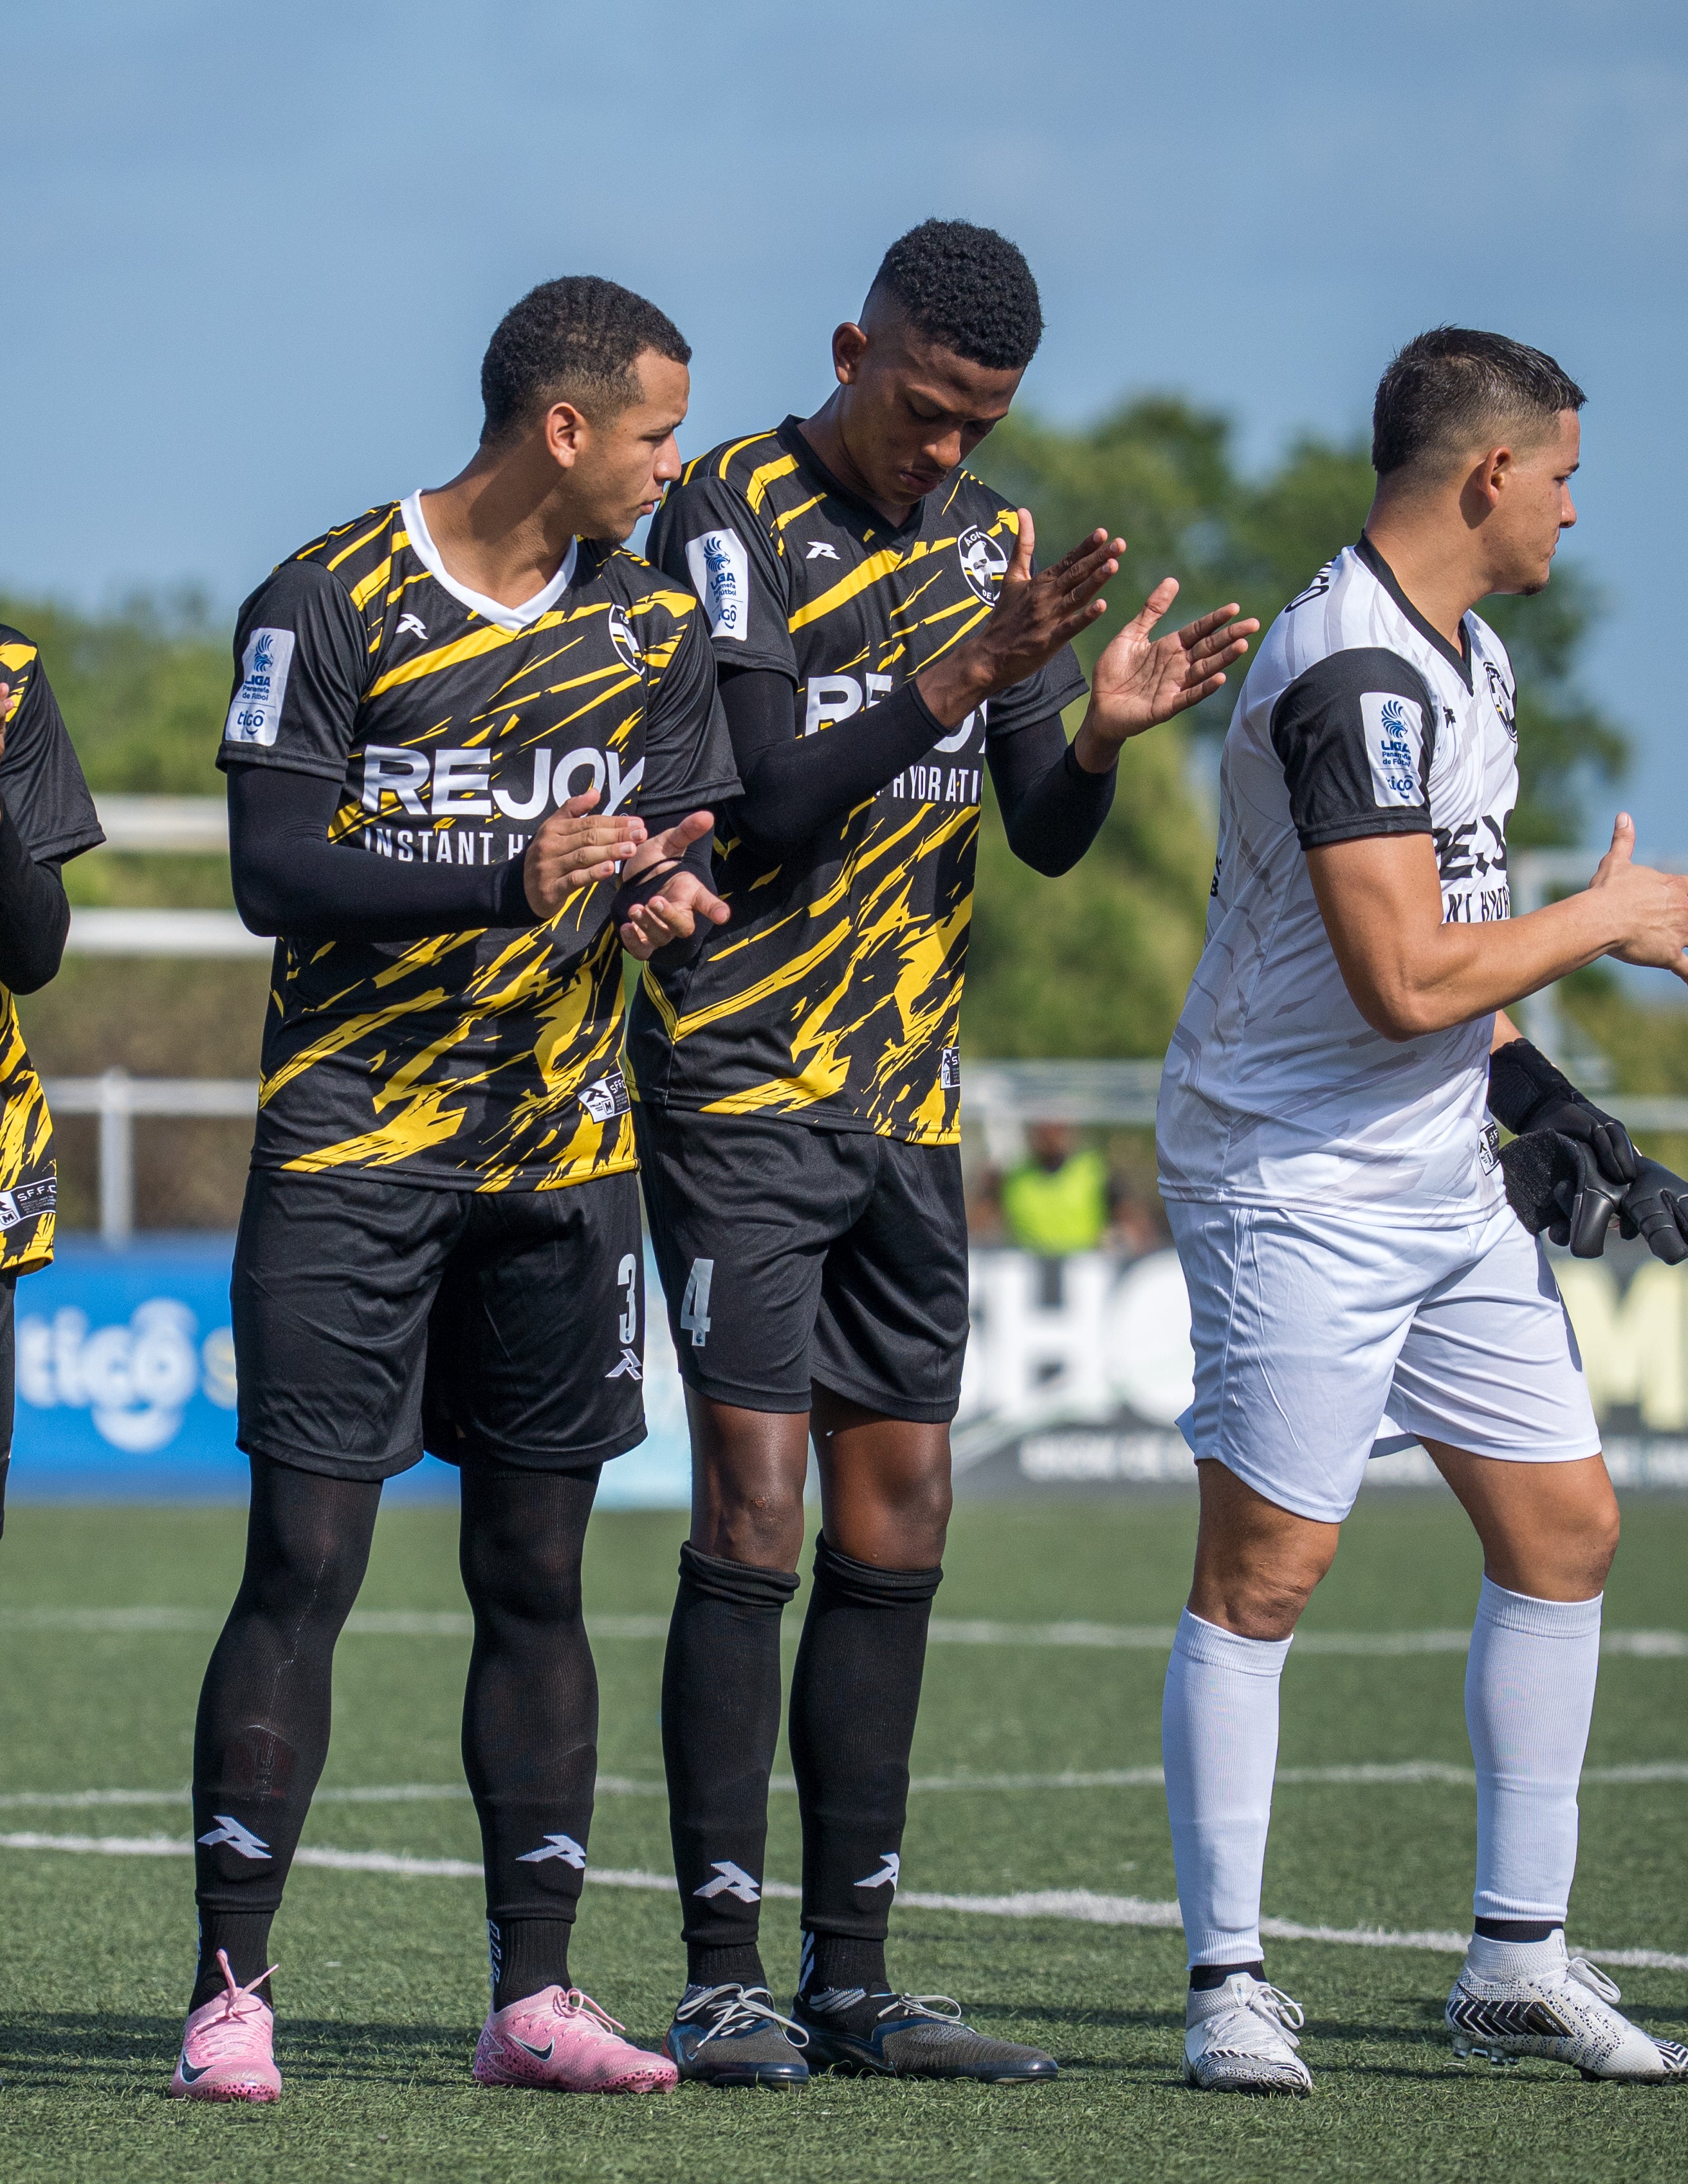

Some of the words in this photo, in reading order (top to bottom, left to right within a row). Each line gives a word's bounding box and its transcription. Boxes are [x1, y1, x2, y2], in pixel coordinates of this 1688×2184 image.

[244, 675, 270, 687] LIGA
[1381, 740, 1411, 754] LIGA
[362, 744, 645, 820] REJOY
[893, 765, 985, 804] HYDRATI
[365, 827, 493, 865] INSTANT
[2, 1213, 15, 1223] M
[618, 1254, 636, 1344] 3
[681, 1258, 714, 1346] 4
